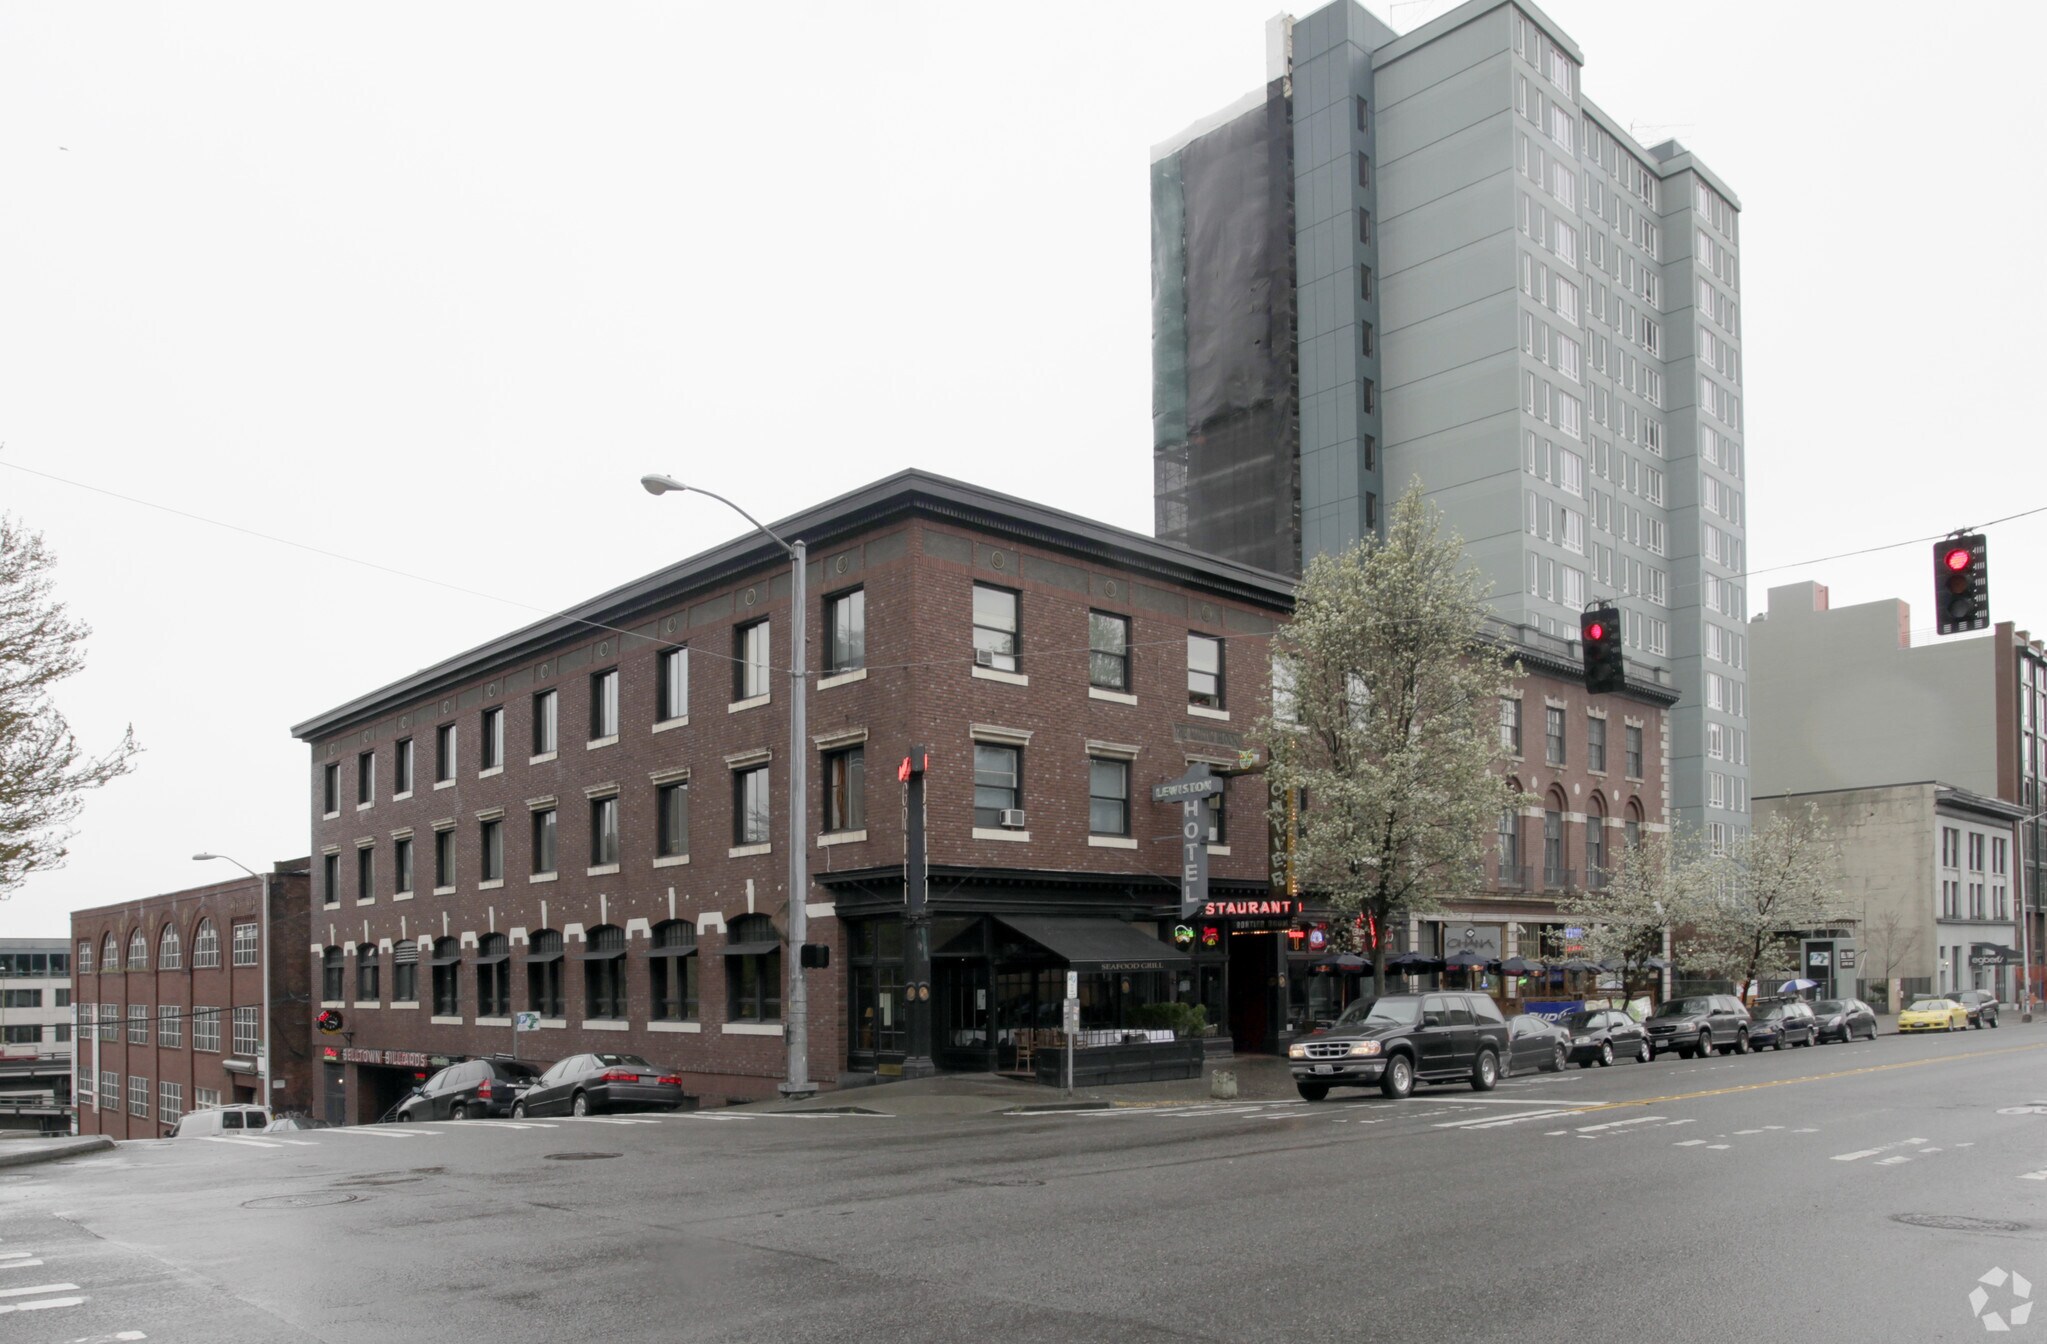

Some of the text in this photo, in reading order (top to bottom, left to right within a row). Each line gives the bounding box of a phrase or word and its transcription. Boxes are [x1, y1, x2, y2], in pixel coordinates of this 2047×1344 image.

[1155, 780, 1212, 798] LEWISTON
[1184, 800, 1199, 903] HOTEL
[1205, 900, 1292, 915] STAURANT
[1101, 961, 1164, 970] SEAFOOD GRILL
[342, 1047, 382, 1064] BELLTOWN
[384, 1050, 427, 1067] BILLIARDS
